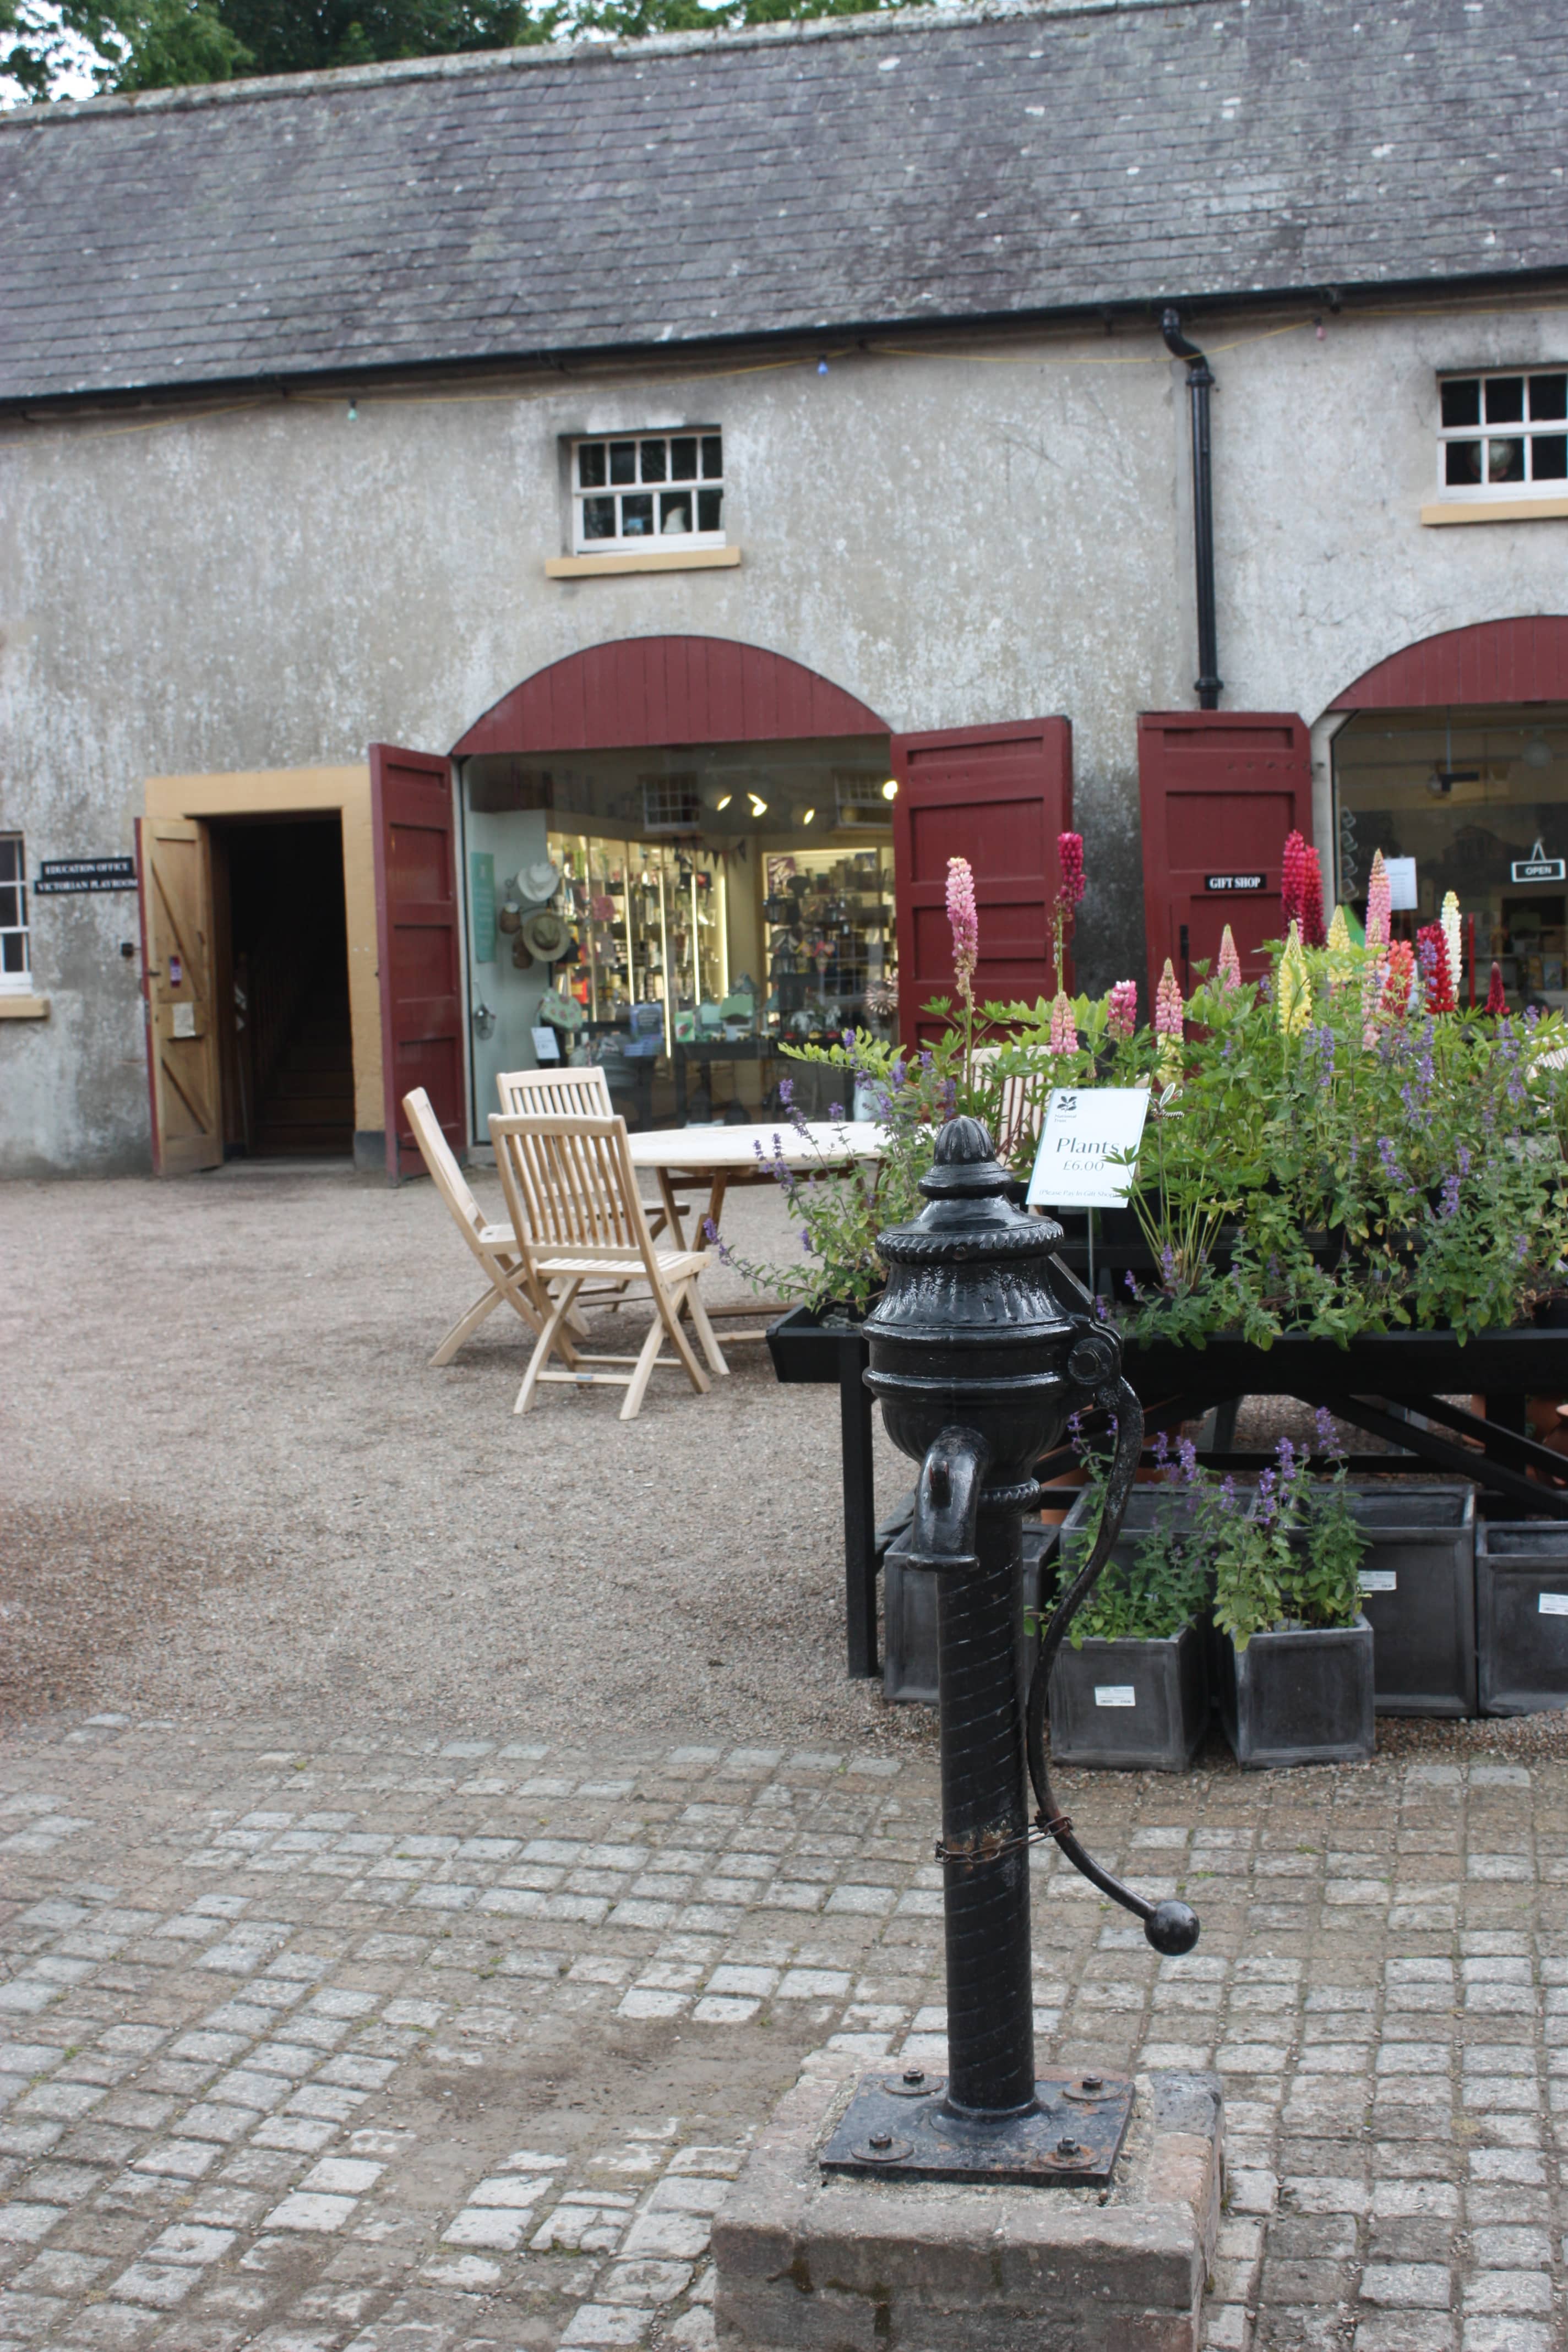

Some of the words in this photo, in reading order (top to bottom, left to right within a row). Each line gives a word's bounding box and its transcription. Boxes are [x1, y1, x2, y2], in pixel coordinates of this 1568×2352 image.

[45, 863, 95, 874] EDUCATION
[96, 862, 128, 872] OFFICE
[1525, 866, 1551, 875] OPEN
[37, 881, 89, 891] VICTORIAN
[1210, 877, 1233, 889] GIFT
[1234, 876, 1261, 888] SHOP
[1057, 1137, 1120, 1154] Plants
[1063, 1160, 1104, 1171] £6.00
